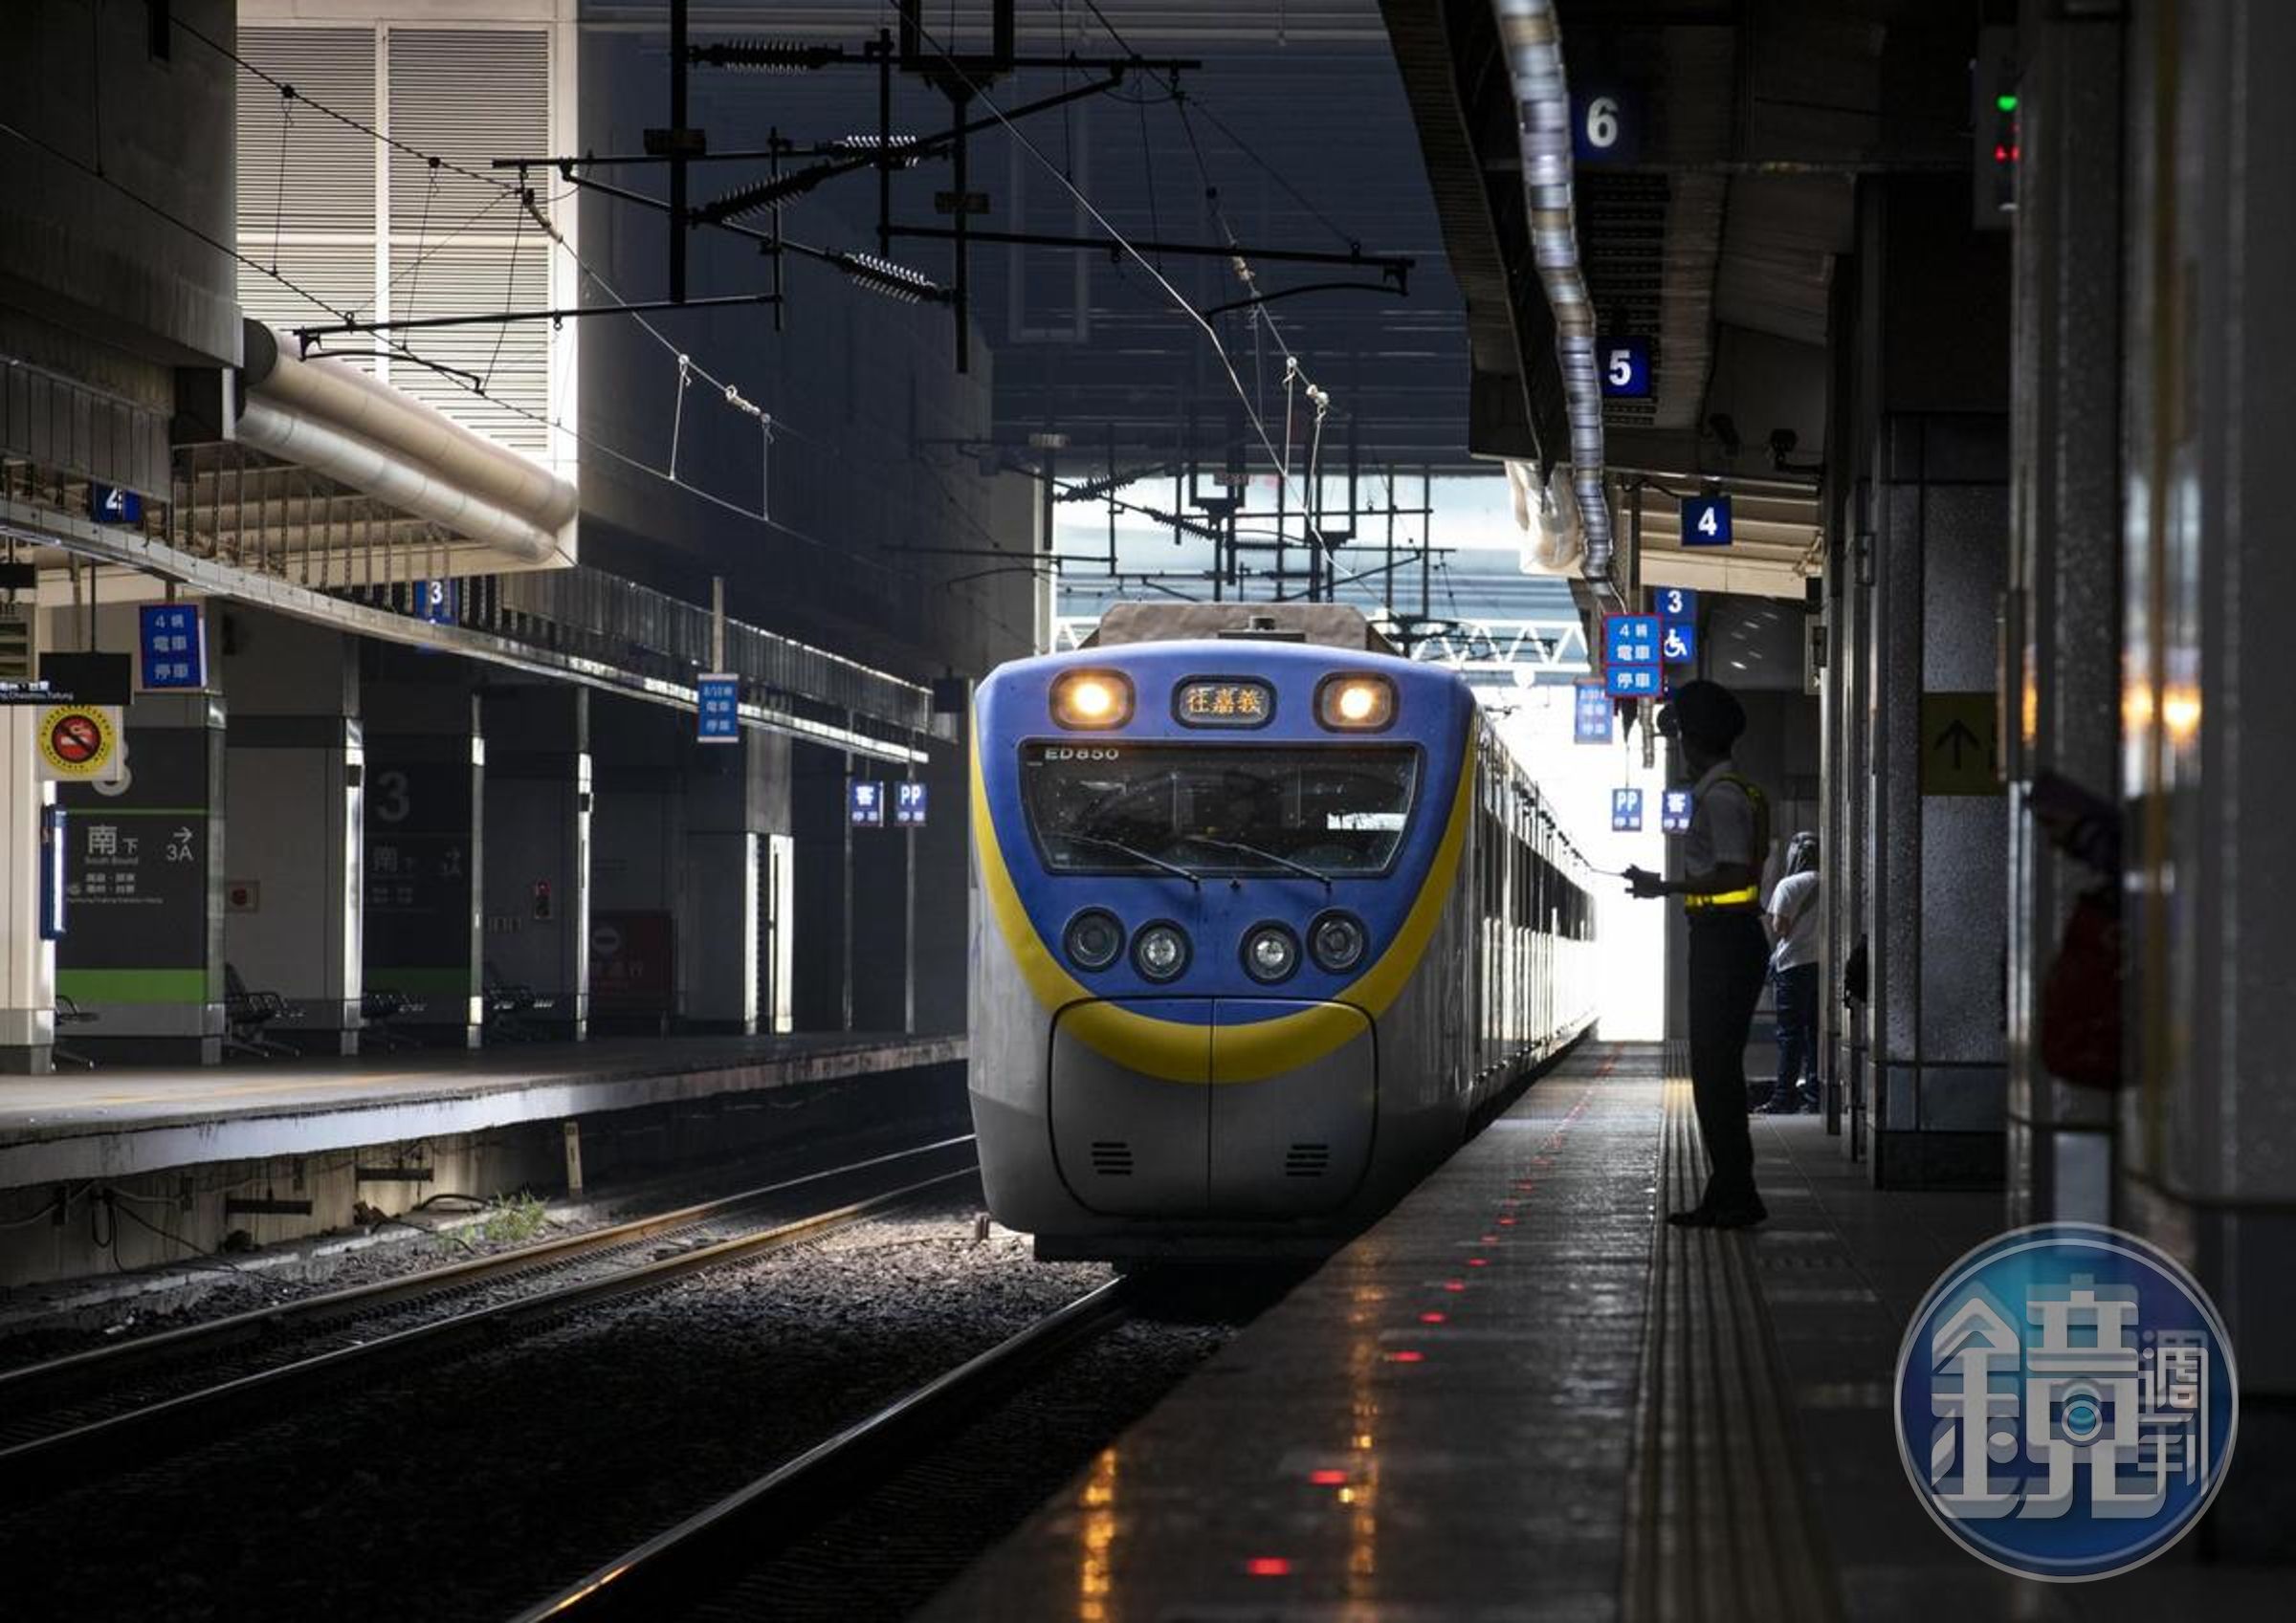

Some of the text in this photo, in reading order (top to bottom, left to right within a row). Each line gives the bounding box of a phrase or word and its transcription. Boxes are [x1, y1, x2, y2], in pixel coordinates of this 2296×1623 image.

[1586, 97, 1619, 148] 6
[1608, 349, 1632, 385] 5
[1697, 507, 1717, 536] 4
[430, 581, 443, 604] 3
[1667, 591, 1683, 613] 3
[1617, 672, 1650, 689] 停車
[1186, 687, 1263, 714] 往嘉義
[1045, 748, 1119, 760] ED850
[900, 784, 921, 806] PP
[1617, 791, 1638, 812] PP
[166, 844, 194, 863] 3A
